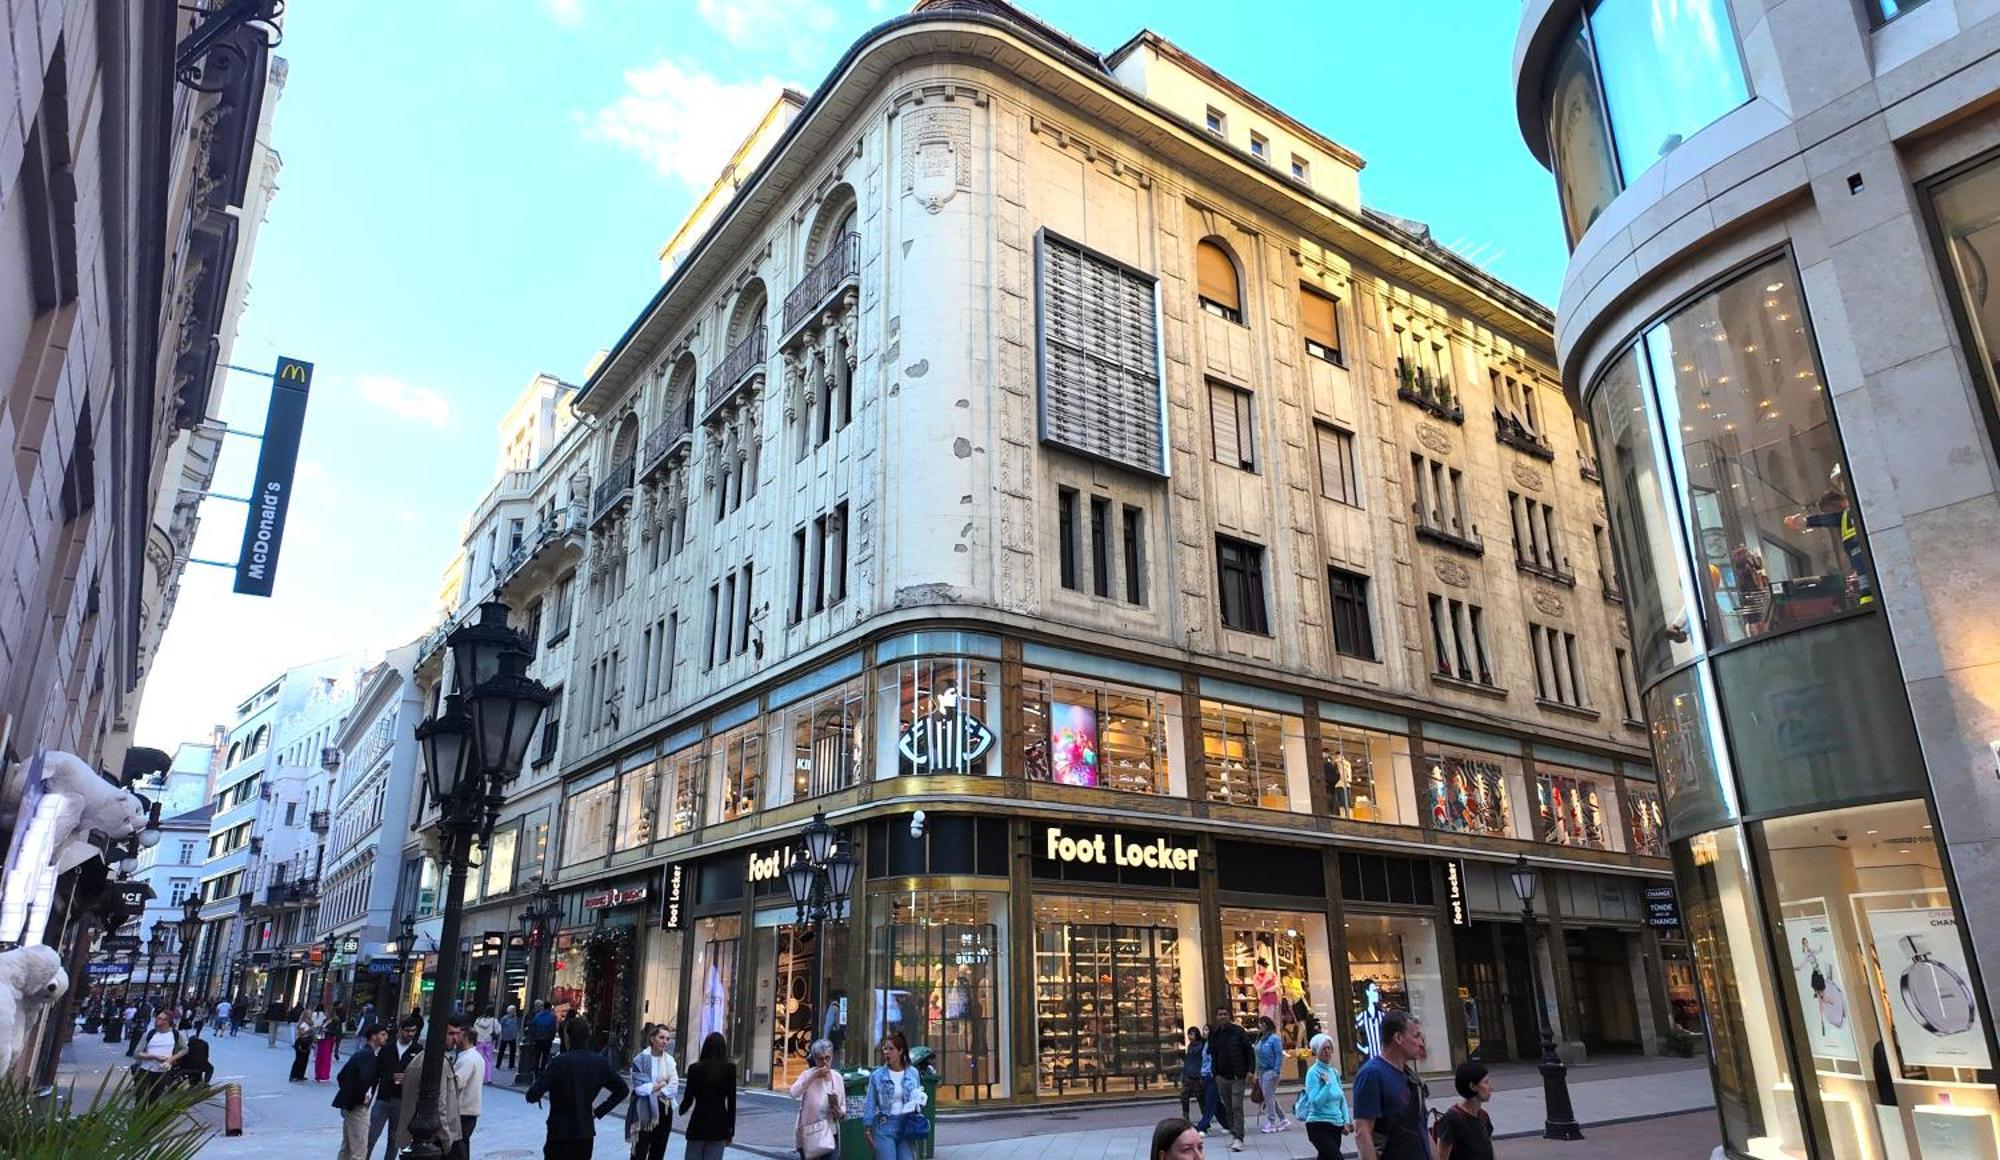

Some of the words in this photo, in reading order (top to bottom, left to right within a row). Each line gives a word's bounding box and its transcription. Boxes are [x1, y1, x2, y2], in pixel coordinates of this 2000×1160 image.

[248, 481, 281, 580] McDonald's
[749, 852, 780, 881] Foot
[1047, 827, 1107, 864] Foot
[1114, 834, 1199, 871] Locker
[670, 865, 682, 901] Locker
[1448, 862, 1460, 898] Locker
[668, 904, 679, 928] Foot
[1452, 901, 1463, 925] Foot
